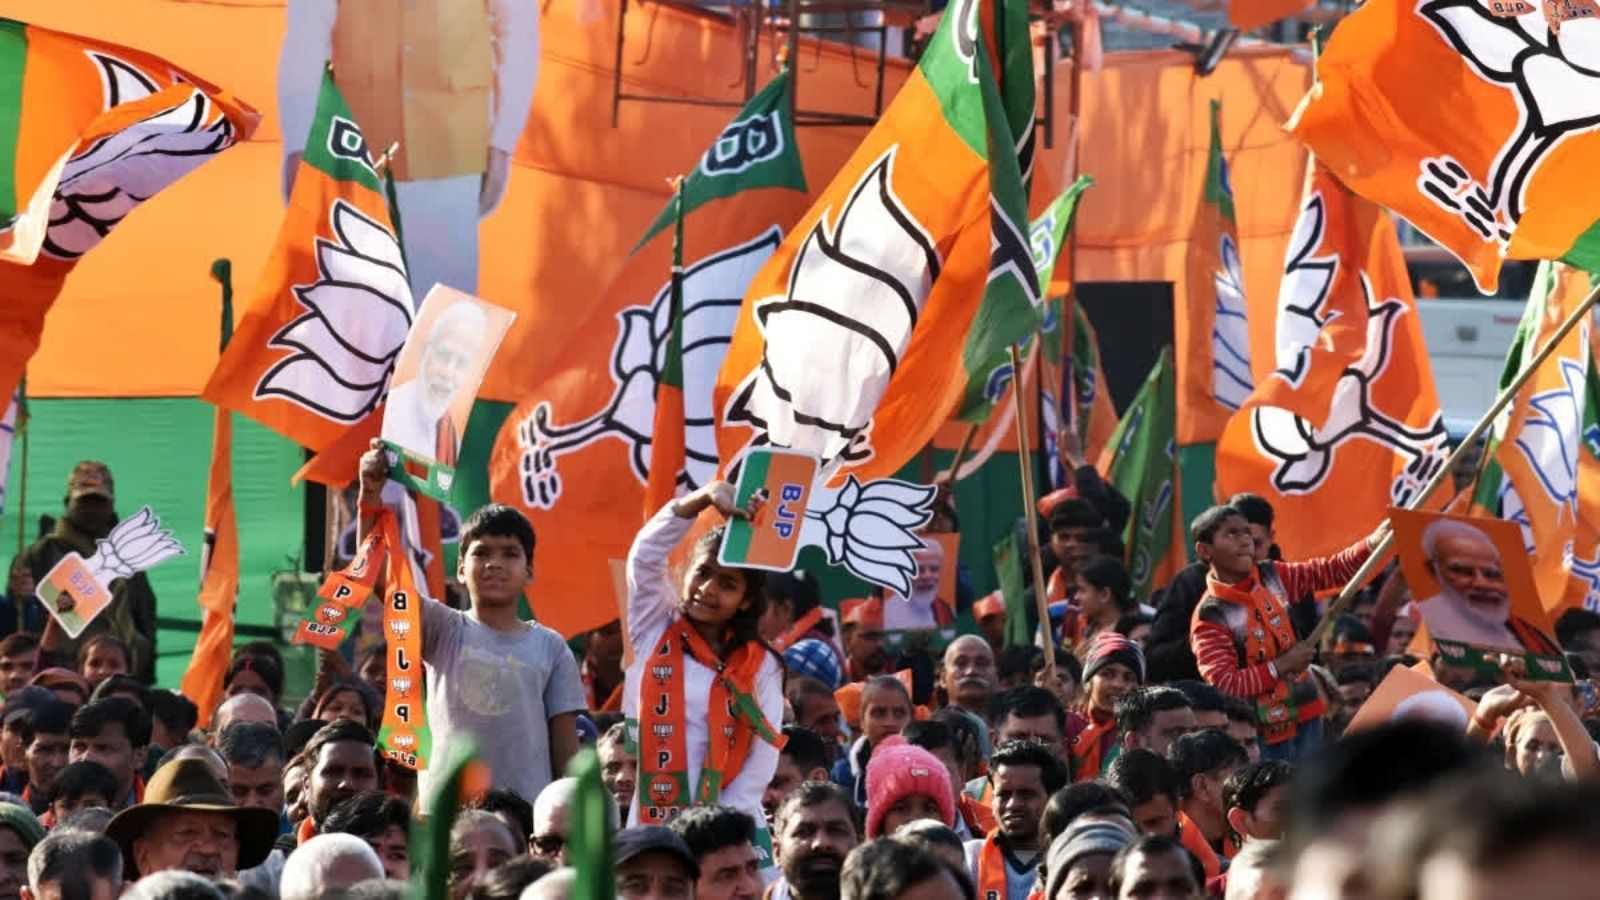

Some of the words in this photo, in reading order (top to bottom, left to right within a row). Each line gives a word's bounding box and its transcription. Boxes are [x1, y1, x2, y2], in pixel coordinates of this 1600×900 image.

[700, 109, 784, 176] B
[774, 484, 803, 539] BJP
[69, 570, 97, 597] BJP
[307, 621, 338, 635] BJP
